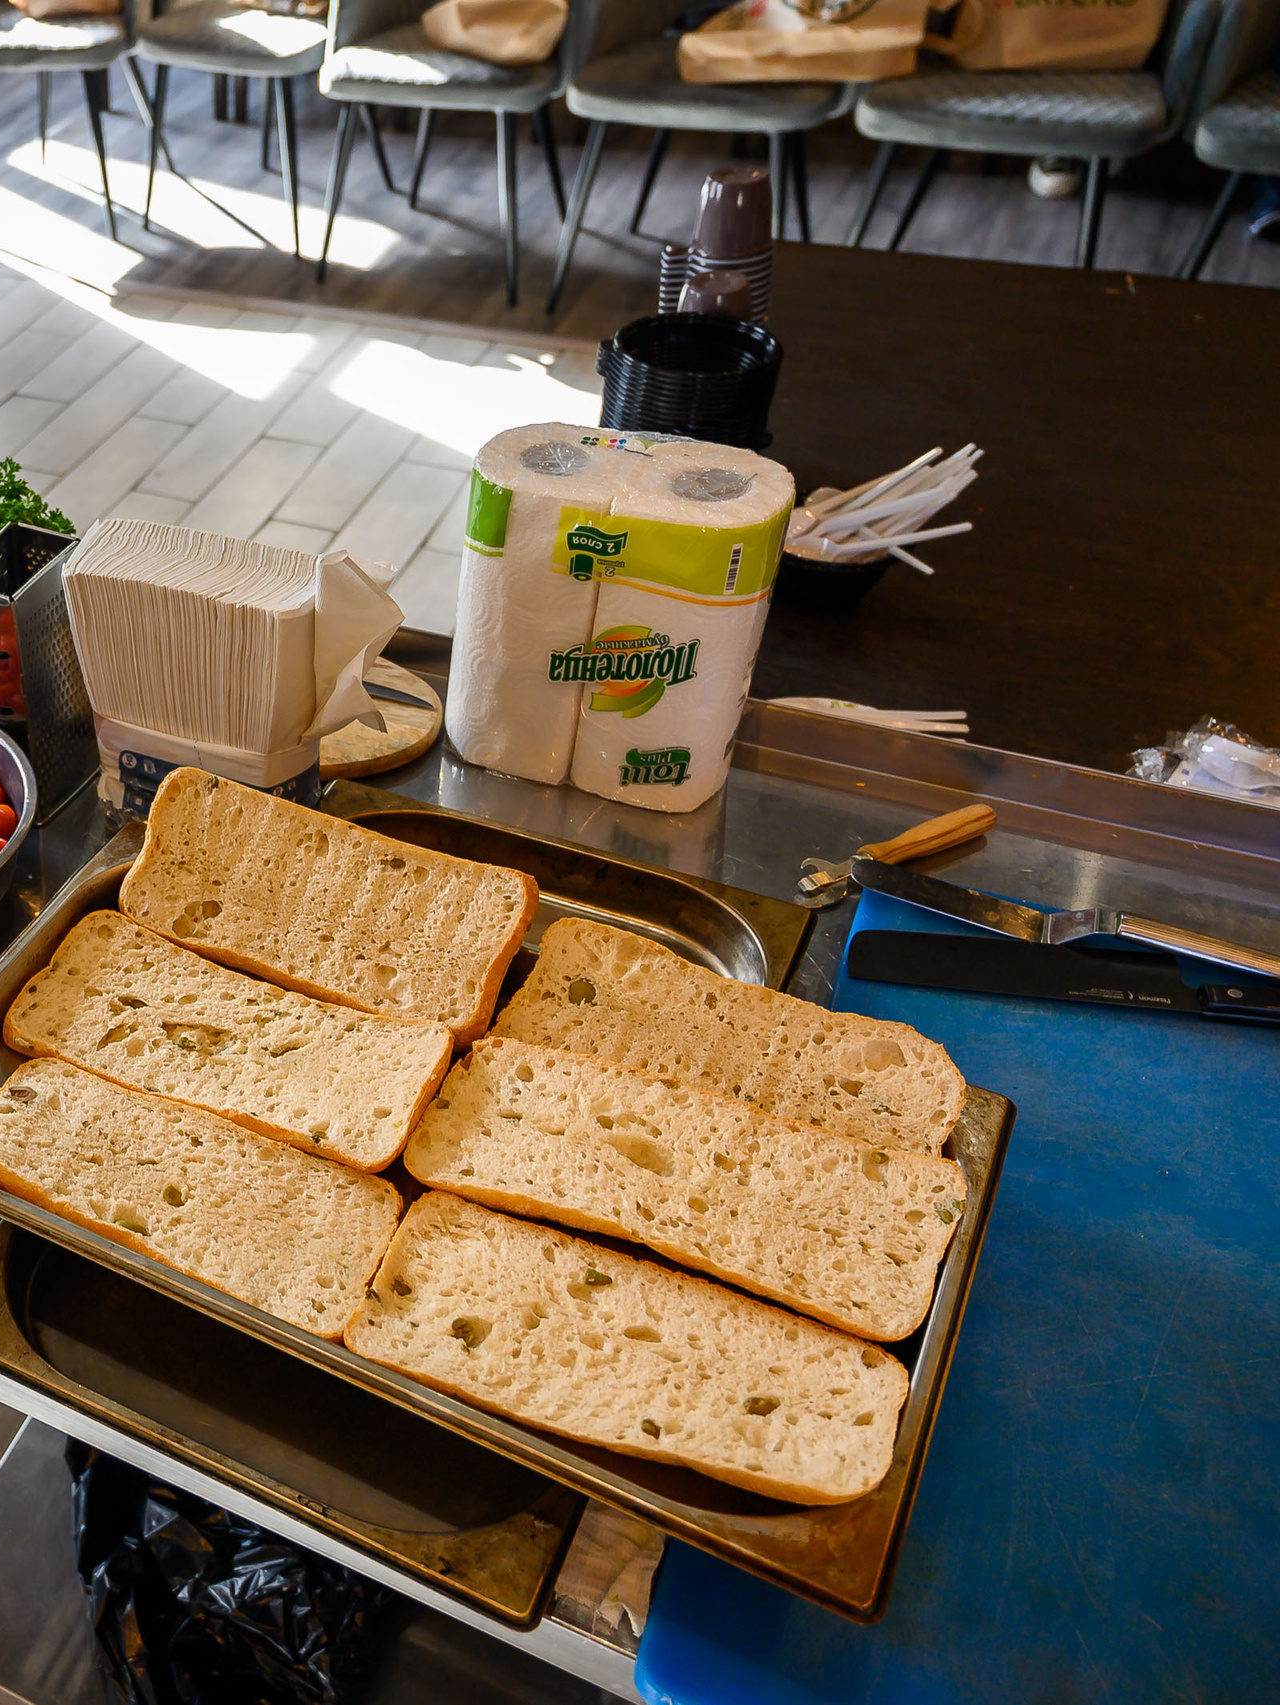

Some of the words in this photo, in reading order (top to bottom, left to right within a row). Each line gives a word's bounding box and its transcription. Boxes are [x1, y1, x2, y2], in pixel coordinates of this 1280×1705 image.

[572, 535, 603, 550] слоя
[606, 542, 615, 553] 2
[605, 567, 615, 577] 2
[596, 633, 670, 650] бумажные
[549, 639, 701, 687] Полотенца
[619, 762, 692, 787] tolli
